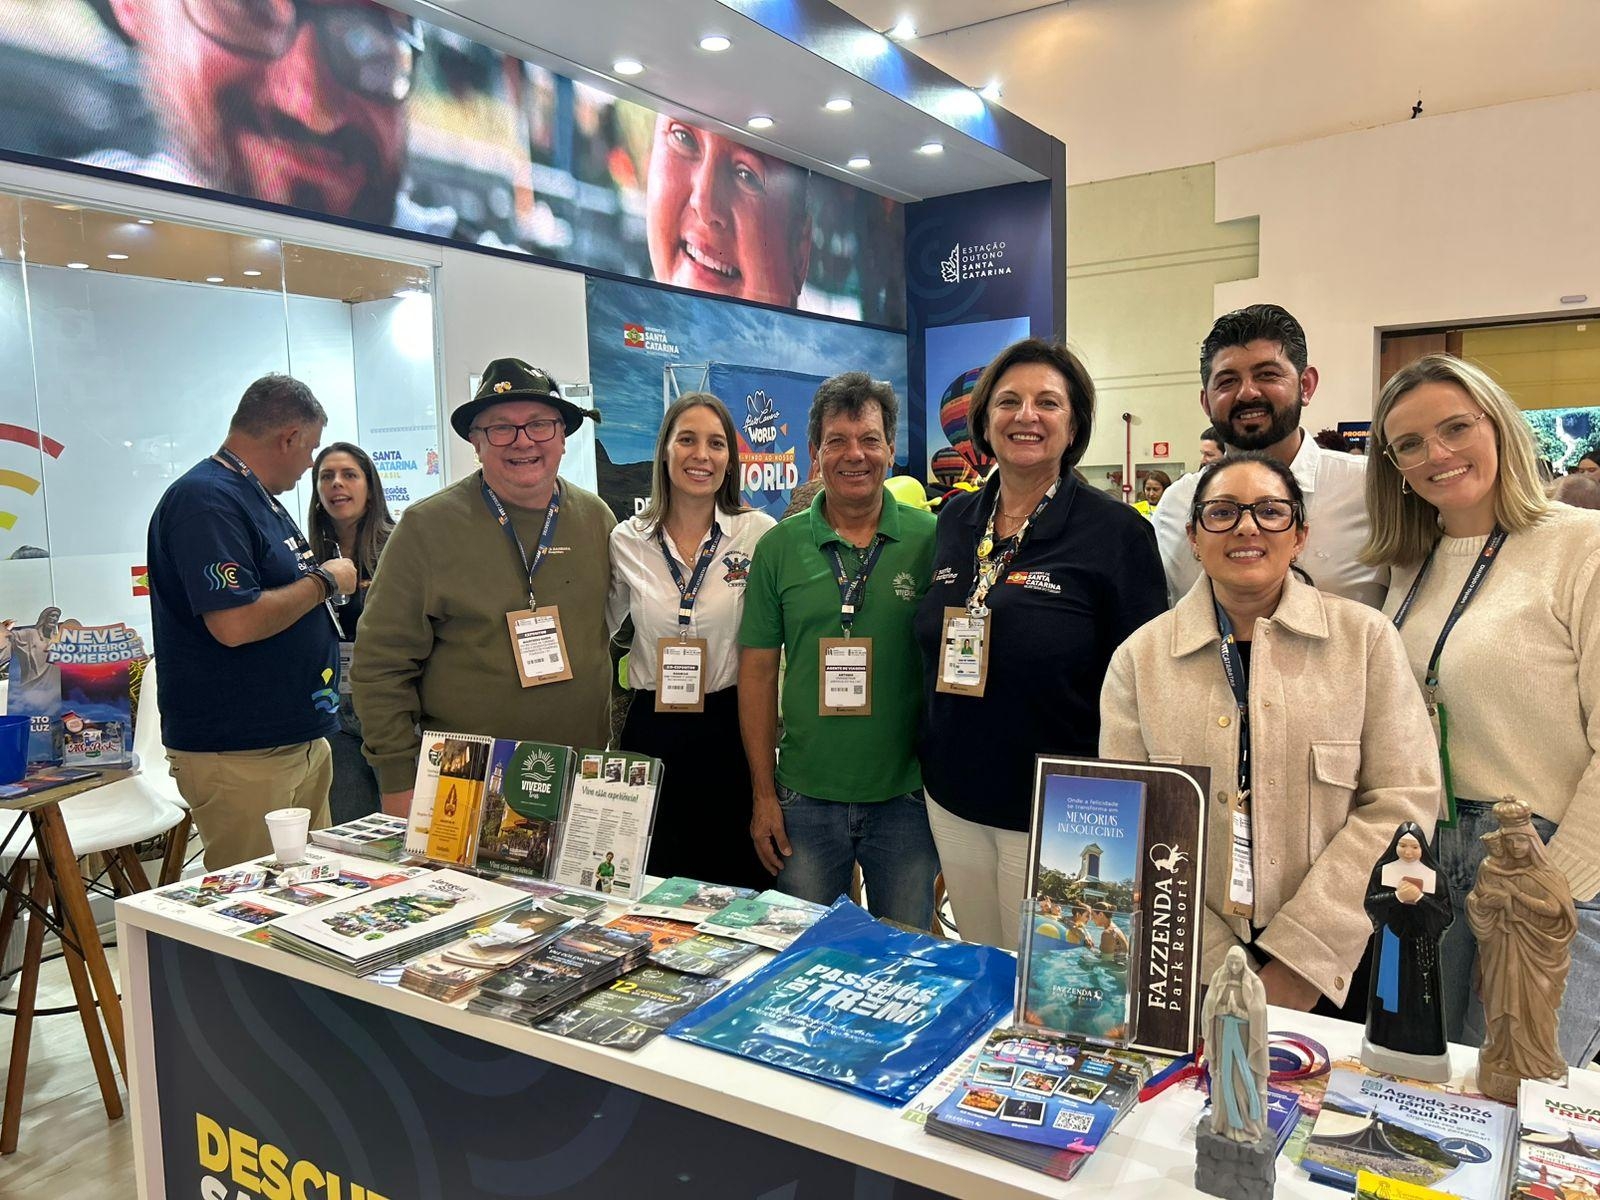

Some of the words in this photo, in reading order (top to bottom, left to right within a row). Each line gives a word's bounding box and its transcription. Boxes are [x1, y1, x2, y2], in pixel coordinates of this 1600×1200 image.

[962, 241, 1006, 254] ESTAÇÃO
[962, 251, 1003, 262] OUTONO
[962, 261, 994, 271] SANTA
[962, 267, 1012, 279] CATARINA
[645, 331, 668, 343] SANTA
[645, 341, 680, 354] CATARINA
[748, 426, 777, 443] WORLD
[372, 451, 402, 461] SANTA
[384, 486, 407, 495] EGIÕES
[1025, 580, 1062, 590] CATARINA
[1027, 574, 1050, 583] SANTA
[60, 627, 125, 643] NEVE
[47, 643, 76, 653] ANO
[80, 641, 128, 653] INTEIRO
[49, 648, 143, 664] POMERODE
[31, 716, 49, 724] STO
[521, 780, 552, 794] VIVERDE
[1075, 804, 1107, 812] transforma
[1090, 799, 1118, 807] felicidade
[1173, 880, 1188, 951] Resort
[1148, 878, 1173, 1009] FAZZENDA
[609, 979, 638, 994] 12
[784, 976, 817, 993] DE
[804, 964, 938, 1004] PASSEIOS
[1052, 984, 1092, 997] FAZZENDA
[1169, 961, 1184, 1011] Park
[1360, 1088, 1436, 1112] Santuário
[1440, 1107, 1487, 1124] Santa
[1384, 1088, 1445, 1108] Agenda
[1449, 1102, 1492, 1119] 2026
[1545, 1098, 1600, 1116] NOVA
[1399, 1104, 1458, 1124] Paulina
[196, 1112, 392, 1200] DESC
